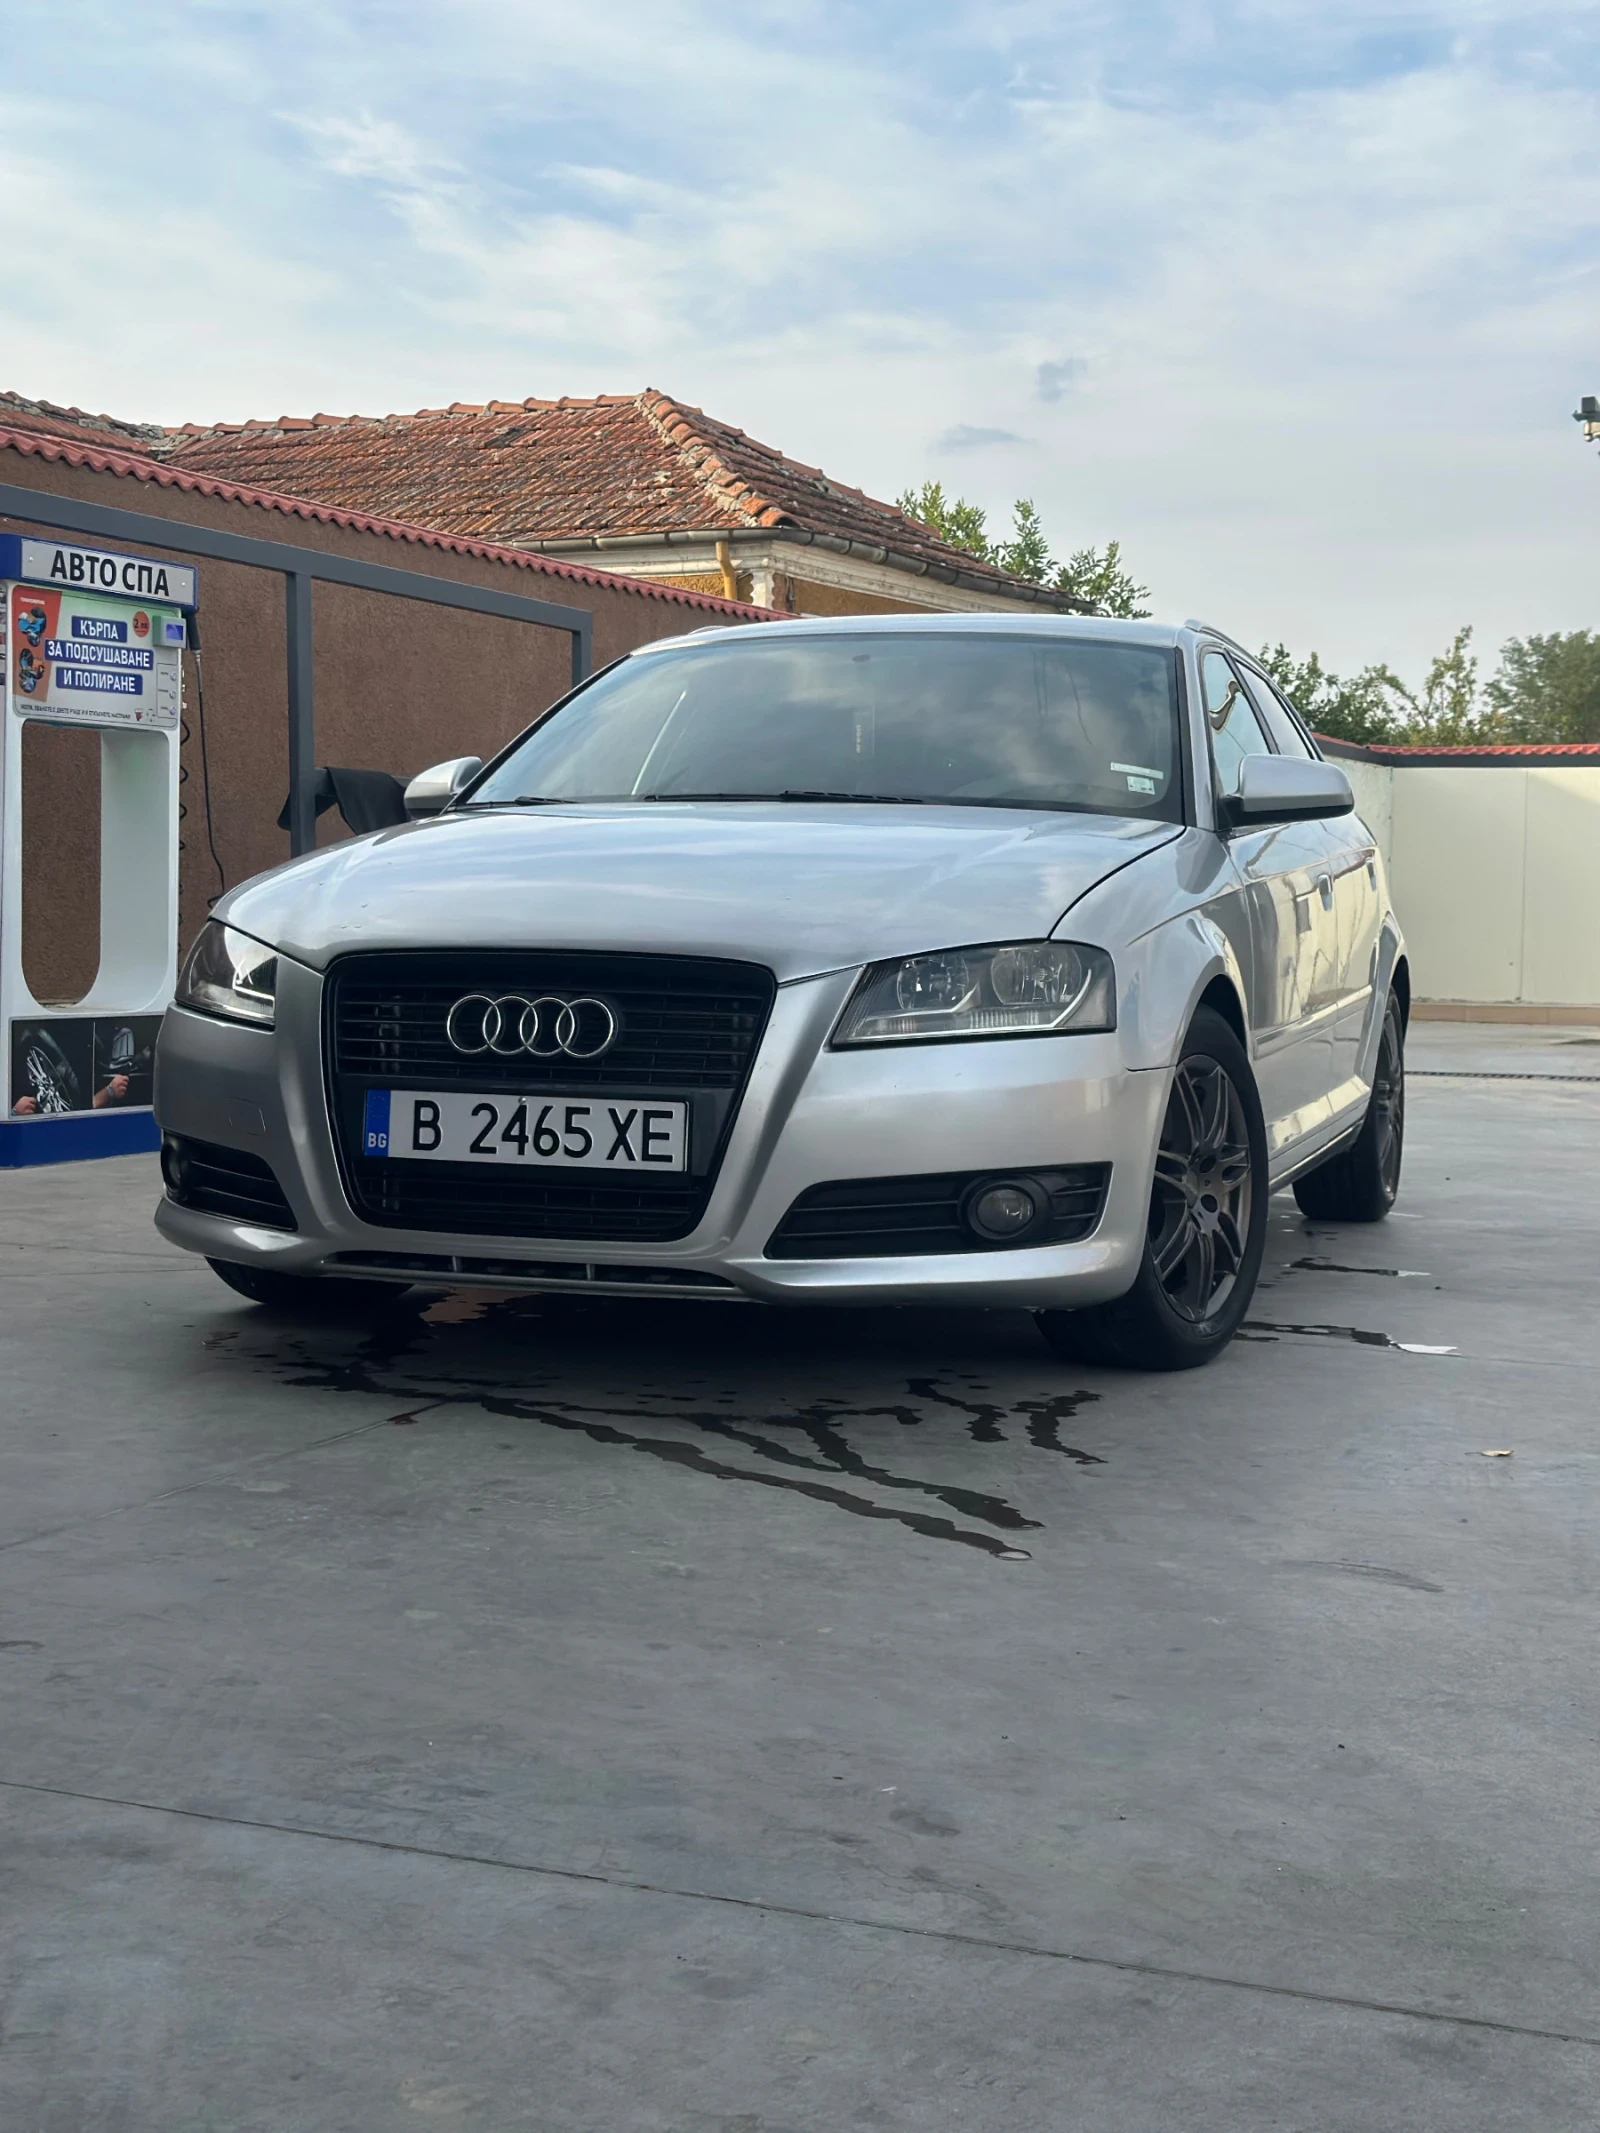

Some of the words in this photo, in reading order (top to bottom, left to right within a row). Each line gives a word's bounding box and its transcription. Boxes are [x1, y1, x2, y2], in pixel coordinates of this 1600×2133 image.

[51, 550, 117, 587] АВТО
[122, 562, 170, 597] СПА
[80, 619, 119, 640] КЪРПА
[48, 640, 63, 658] ЗА
[66, 643, 150, 668] ПОДСУШАВАНЕ
[63, 669, 72, 685] И
[75, 671, 136, 692] ПОЛИРАНЕ
[367, 1132, 388, 1149] BG
[412, 1099, 443, 1152] B
[469, 1102, 594, 1159] 2465
[606, 1107, 674, 1164] XE
